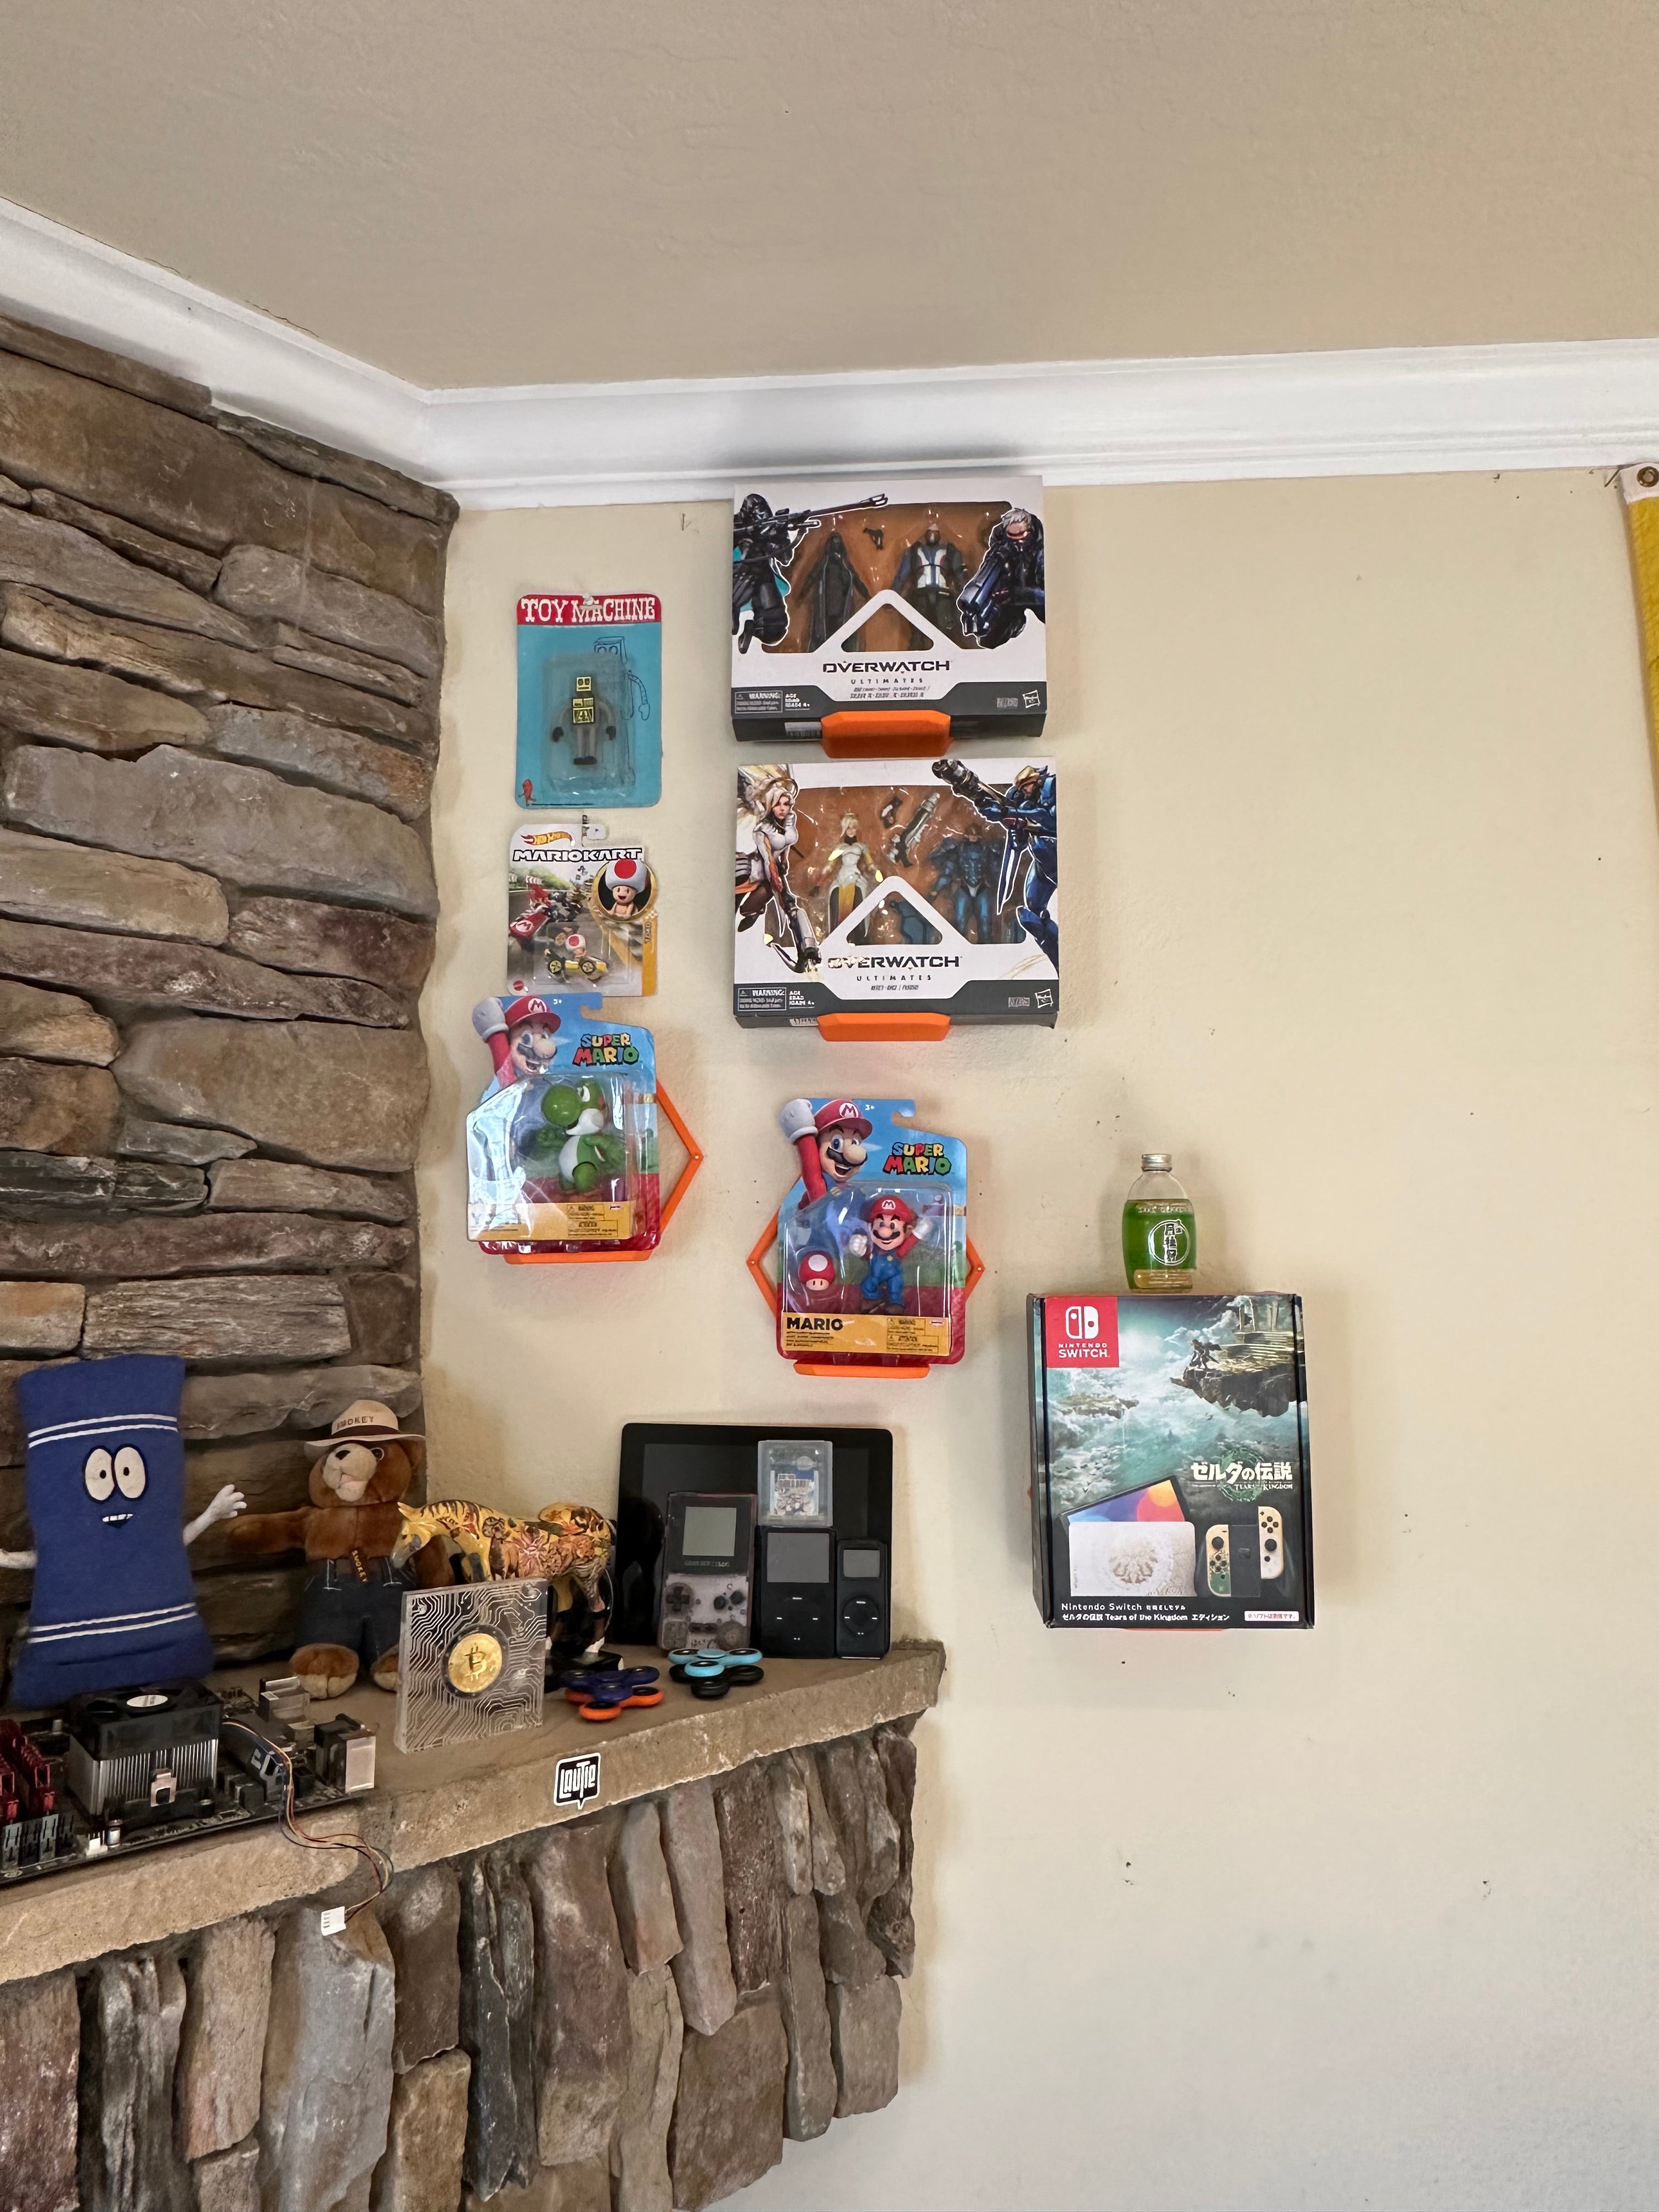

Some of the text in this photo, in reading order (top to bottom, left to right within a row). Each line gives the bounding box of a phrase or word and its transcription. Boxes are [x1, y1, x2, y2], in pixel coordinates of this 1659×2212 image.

[521, 596, 656, 623] TOY MACHINE
[822, 660, 950, 674] OVERWATCH
[827, 956, 960, 970] OVERWATCH
[580, 1034, 631, 1047] SUPER
[572, 1046, 639, 1066] MARIO
[891, 1142, 944, 1156] SUPER
[882, 1155, 952, 1176] MARIO
[787, 1317, 844, 1331] MARIO
[1058, 1348, 1108, 1358] SWITCH
[1190, 1462, 1293, 1485] ゼルダの伝説
[1061, 1602, 1105, 1611] Nintendo
[1109, 1602, 1142, 1611] Switch
[1154, 1613, 1188, 1622] Kingdom
